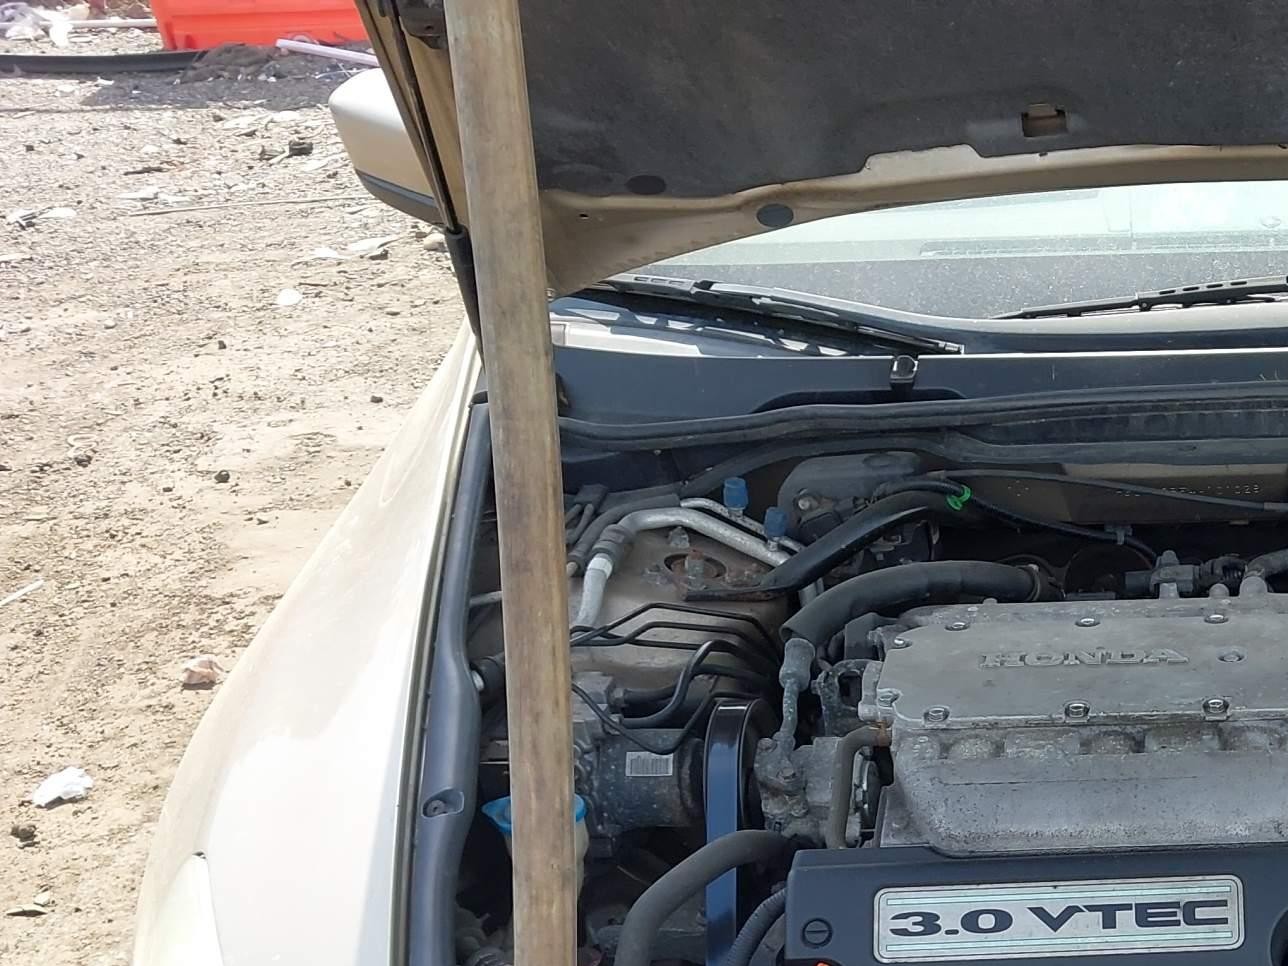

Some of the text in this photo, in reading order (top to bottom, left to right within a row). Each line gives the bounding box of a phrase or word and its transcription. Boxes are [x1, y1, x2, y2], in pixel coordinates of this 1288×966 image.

[978, 647, 1189, 668] HONDA
[889, 899, 1229, 937] 3.0 VTEC
